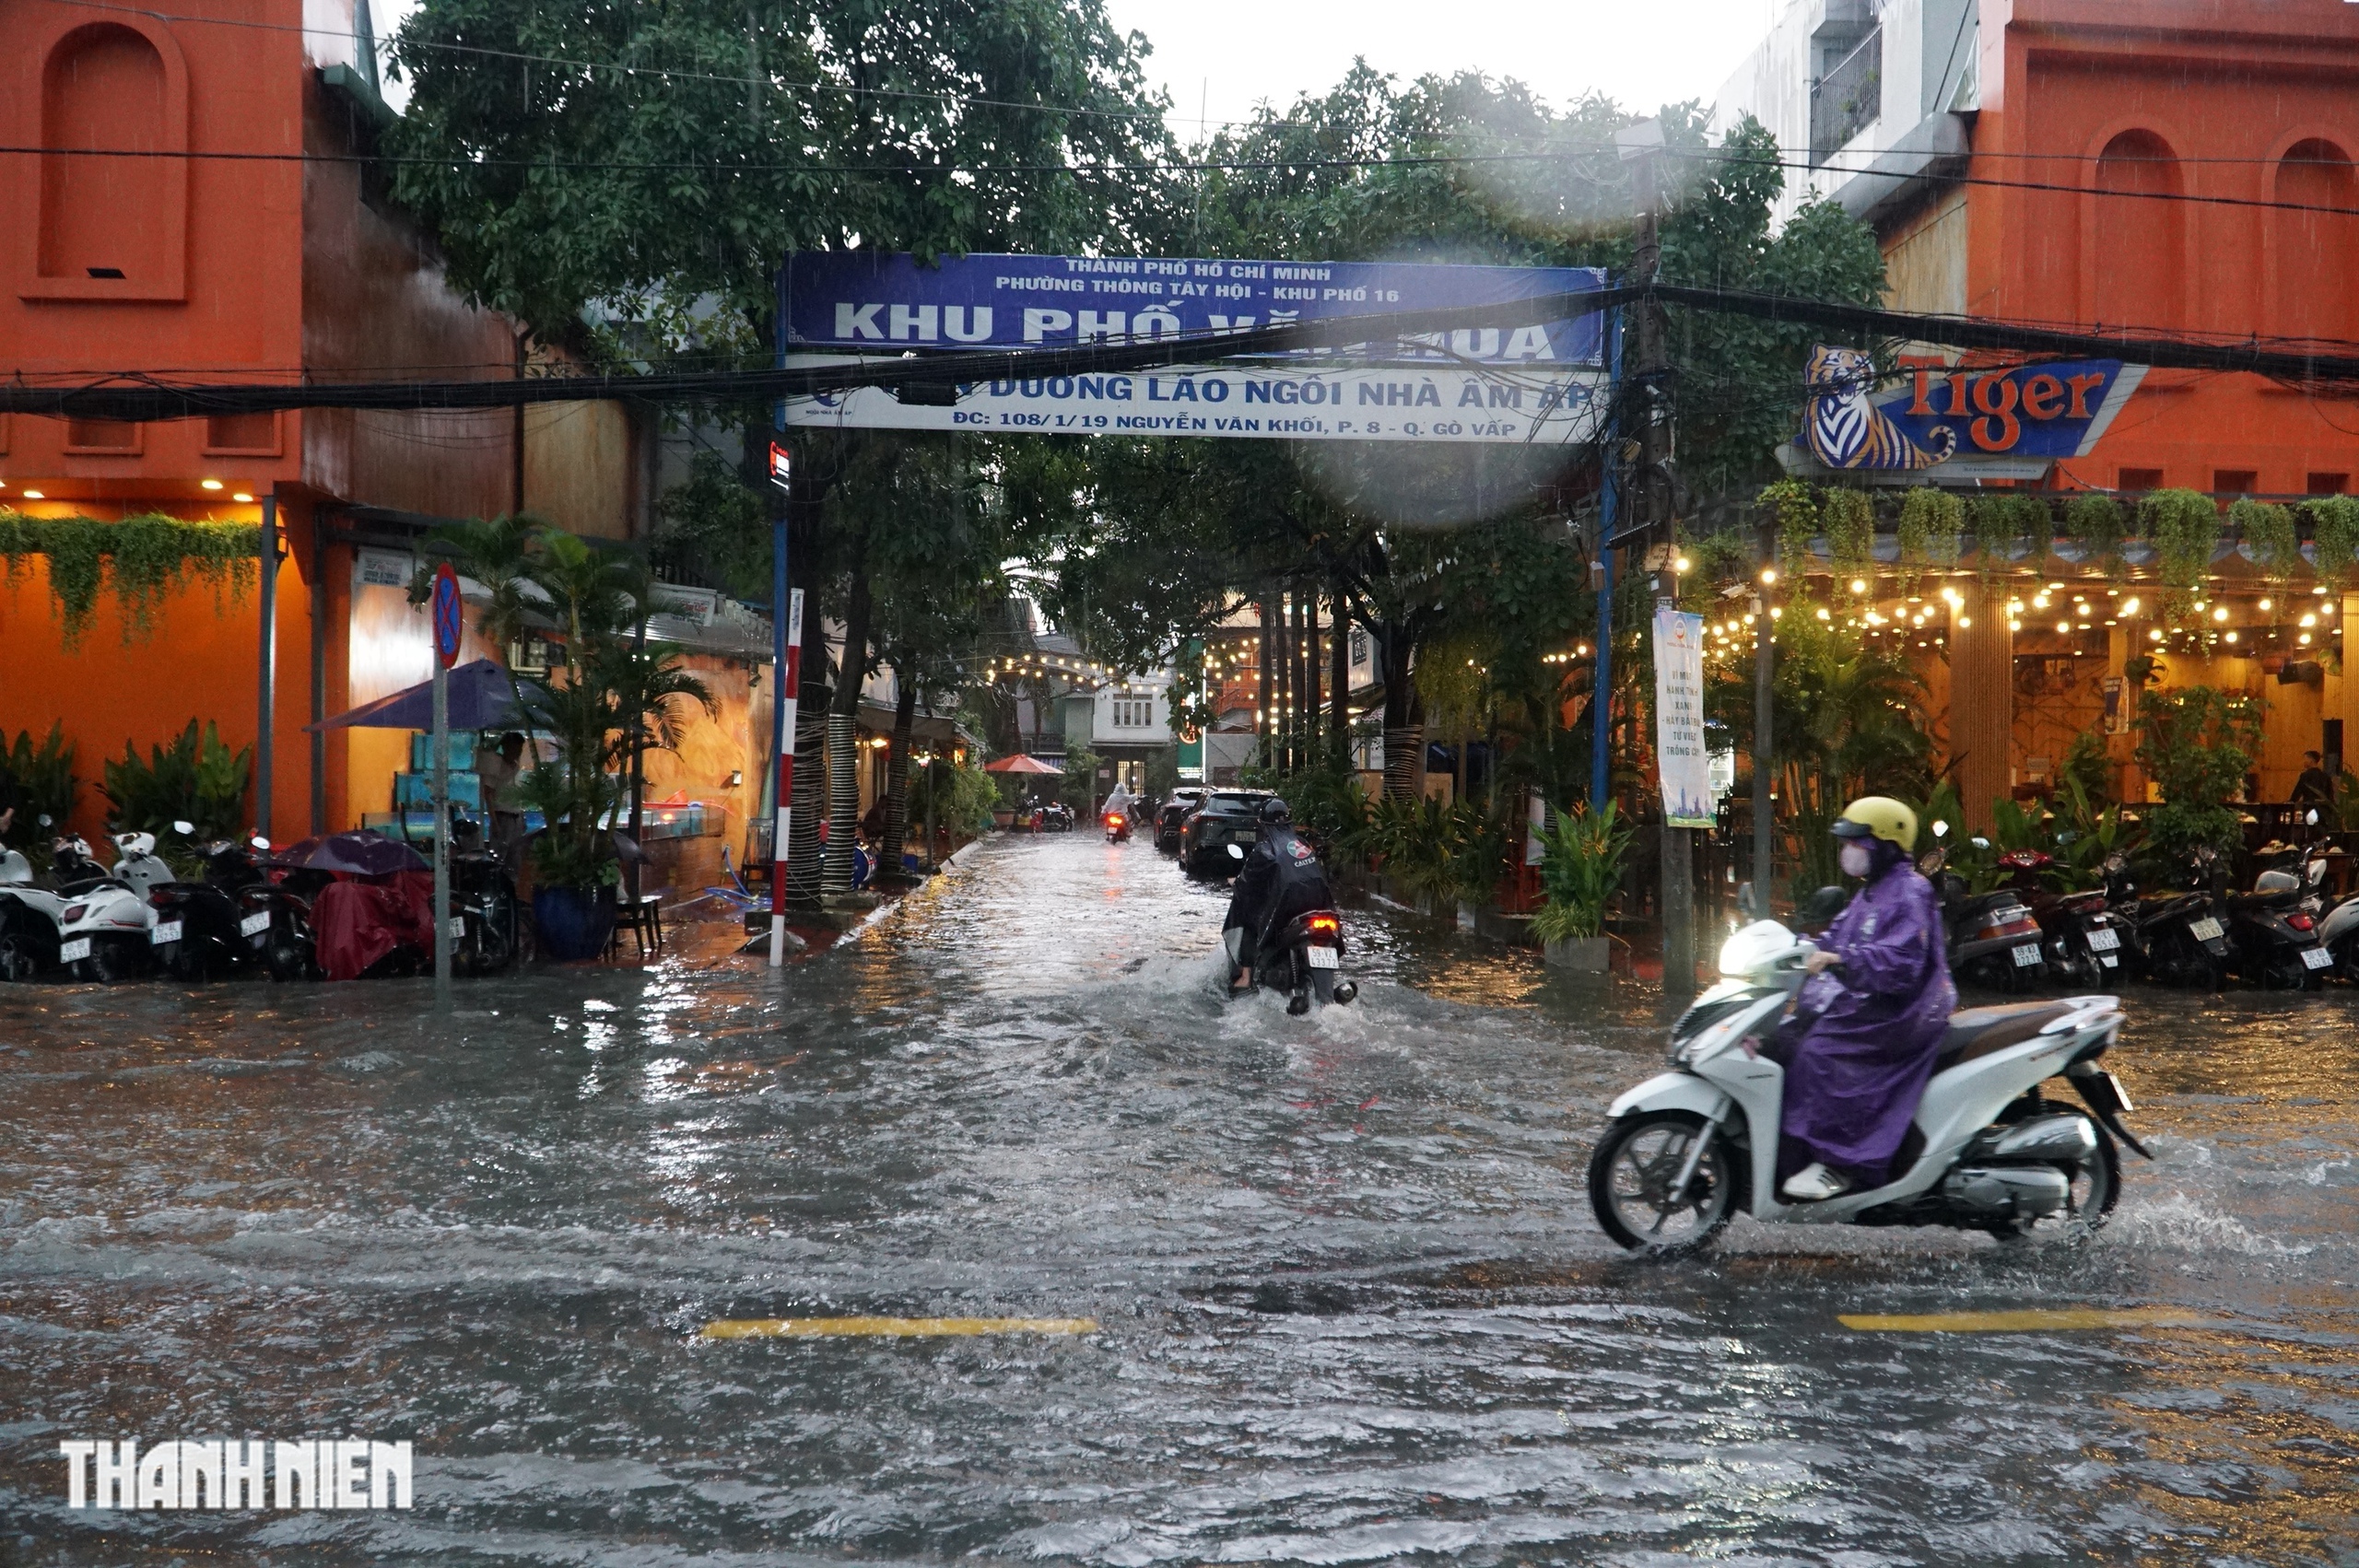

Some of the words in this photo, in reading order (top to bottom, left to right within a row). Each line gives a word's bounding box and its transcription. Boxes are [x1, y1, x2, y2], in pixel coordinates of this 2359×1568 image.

[1230, 263, 1265, 279] CHÍ
[1273, 267, 1331, 281] MINH
[996, 275, 1085, 292] PHƯỜNG
[1092, 278, 1163, 295] THÔNG
[1169, 281, 1209, 297] TÂY
[1215, 283, 1251, 300] HỘI
[1273, 287, 1317, 300] KHU
[1323, 285, 1367, 302] PHỐ
[1374, 290, 1400, 302] 16
[835, 302, 993, 342] KHU
[1023, 300, 1185, 347] PHỐ
[1245, 373, 1342, 405] NGÔI
[1358, 376, 1441, 407] NHÀ
[1896, 354, 2106, 452] Tiger
[953, 411, 991, 425] ĐC:
[1116, 411, 1207, 430] NGUYỄN
[1214, 415, 1260, 431] VĂN
[1268, 415, 1330, 435] KHỐI,
[1338, 421, 1358, 434] P.
[1367, 421, 1381, 435] 8
[1433, 419, 1463, 436] GÒ
[1471, 419, 1517, 437] VẤP
